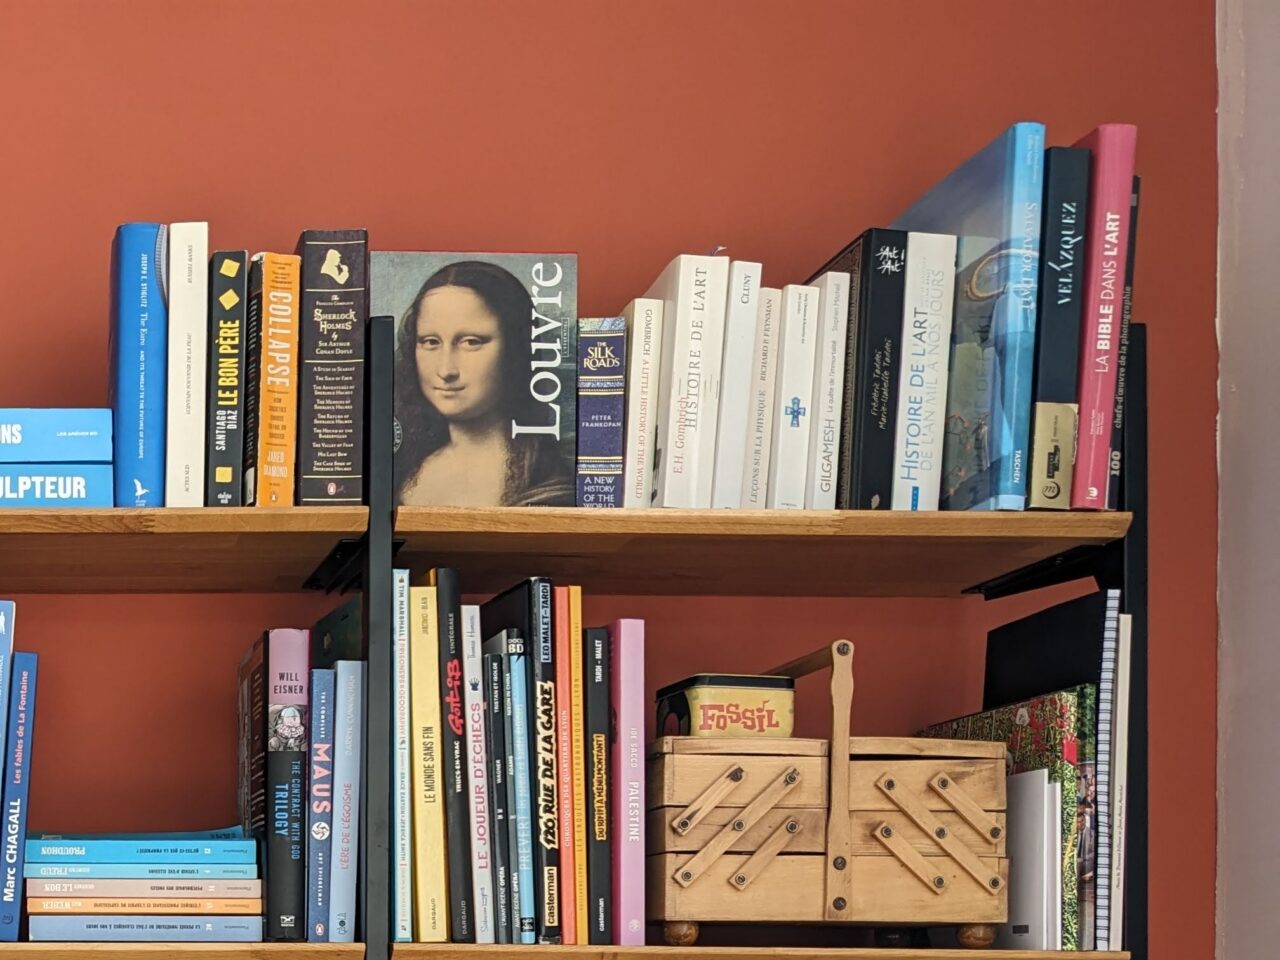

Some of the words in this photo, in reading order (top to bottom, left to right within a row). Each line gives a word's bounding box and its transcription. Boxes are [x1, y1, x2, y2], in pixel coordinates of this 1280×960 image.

[1102, 211, 1121, 256] L'ART
[1047, 201, 1083, 305] VELÁZQUEZ
[693, 266, 708, 313] L'ART
[1100, 260, 1118, 300] DANS
[215, 319, 239, 354] PÈRE
[265, 291, 293, 387] COLLAPSE
[690, 320, 703, 342] DE
[910, 306, 929, 357] L'ART
[1097, 304, 1115, 350] BIBLE
[511, 261, 563, 441] Louvre
[583, 357, 620, 371] ROADS
[587, 346, 615, 358] SILK
[1094, 355, 1110, 373] LA
[218, 357, 238, 386] BON
[909, 364, 926, 387] DE
[218, 390, 238, 406] LE
[685, 349, 702, 429] HISTOIRE
[215, 410, 227, 450] SANTIAGO
[675, 396, 690, 449] Gombrich
[900, 396, 924, 481] HISTOIRE
[819, 418, 836, 493] GILGAMESH
[1012, 449, 1022, 484] TASCHEN
[583, 485, 615, 493] HISTORY
[584, 476, 592, 484] A
[593, 476, 615, 484] NEW
[583, 494, 597, 503] OF
[598, 494, 615, 503] THE
[508, 644, 524, 654] BD
[18, 670, 29, 711] Fontaine
[273, 684, 304, 695] EISNER
[279, 672, 300, 682] WILL
[16, 713, 26, 724] La
[537, 681, 554, 731] GARE
[15, 725, 25, 738] de
[421, 726, 434, 740] FIN
[470, 702, 486, 778] D'ÉCHECS
[538, 734, 554, 755] LA
[630, 727, 638, 740] JOE
[14, 739, 24, 767] fables
[423, 741, 435, 762] SANS
[630, 743, 638, 768] SACCO
[13, 768, 22, 785] Les
[291, 761, 301, 774] THE
[311, 743, 332, 815] MAUS
[424, 763, 436, 792] MONDE
[540, 757, 556, 782] DE
[275, 783, 289, 836] TRILOGY
[291, 778, 301, 818] CONTRACT
[425, 794, 436, 804] LE
[540, 784, 557, 815] RUE
[628, 781, 640, 842] PALESTINE
[474, 784, 487, 846] JOUEUR
[5, 798, 21, 863] CHAGALL
[291, 821, 300, 842] WITH
[291, 844, 300, 860] GOD
[477, 850, 489, 870] LE
[3, 866, 17, 902] Marc
[545, 868, 557, 925] casterman
